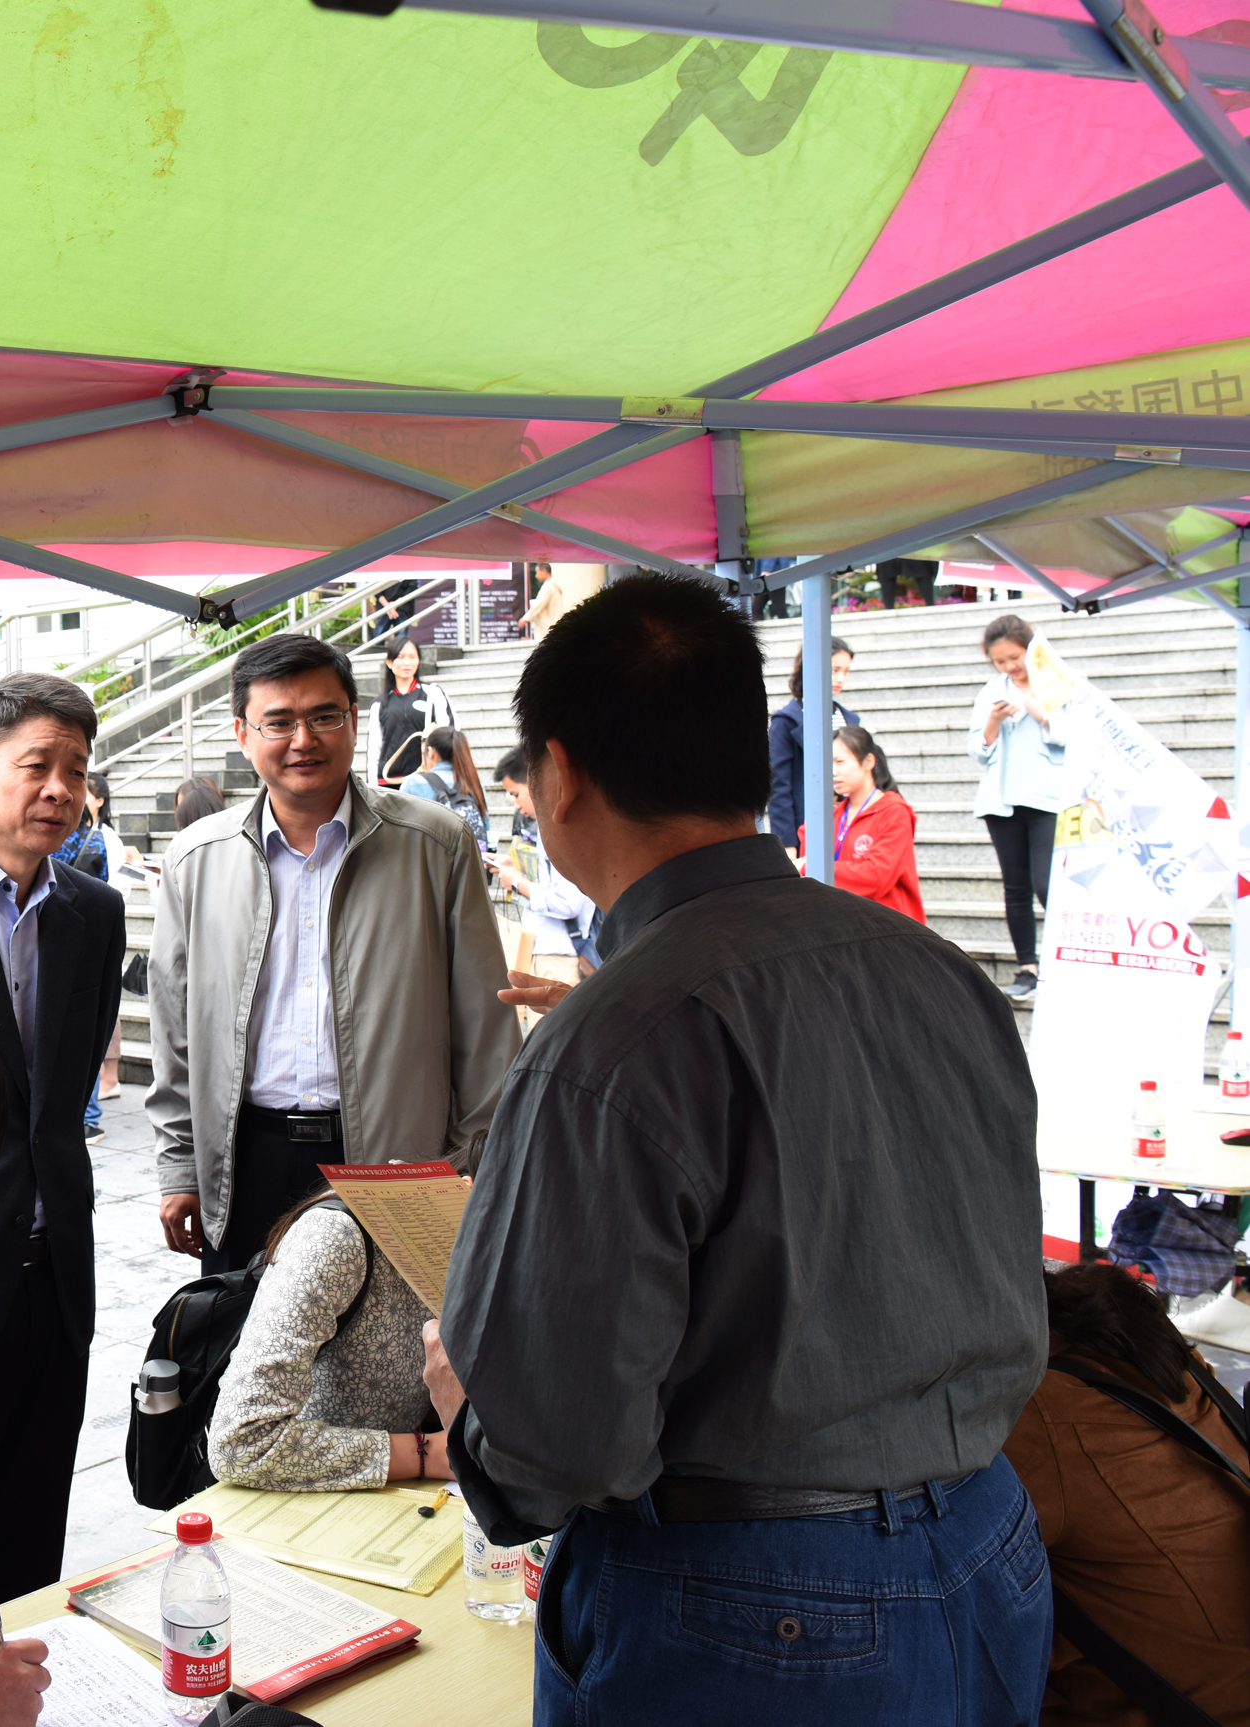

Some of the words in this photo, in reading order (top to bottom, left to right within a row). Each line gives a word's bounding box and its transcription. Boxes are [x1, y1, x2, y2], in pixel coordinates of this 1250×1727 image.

[525, 1566, 541, 1582] 农夫
[186, 1659, 226, 1675] 农夫山泉
